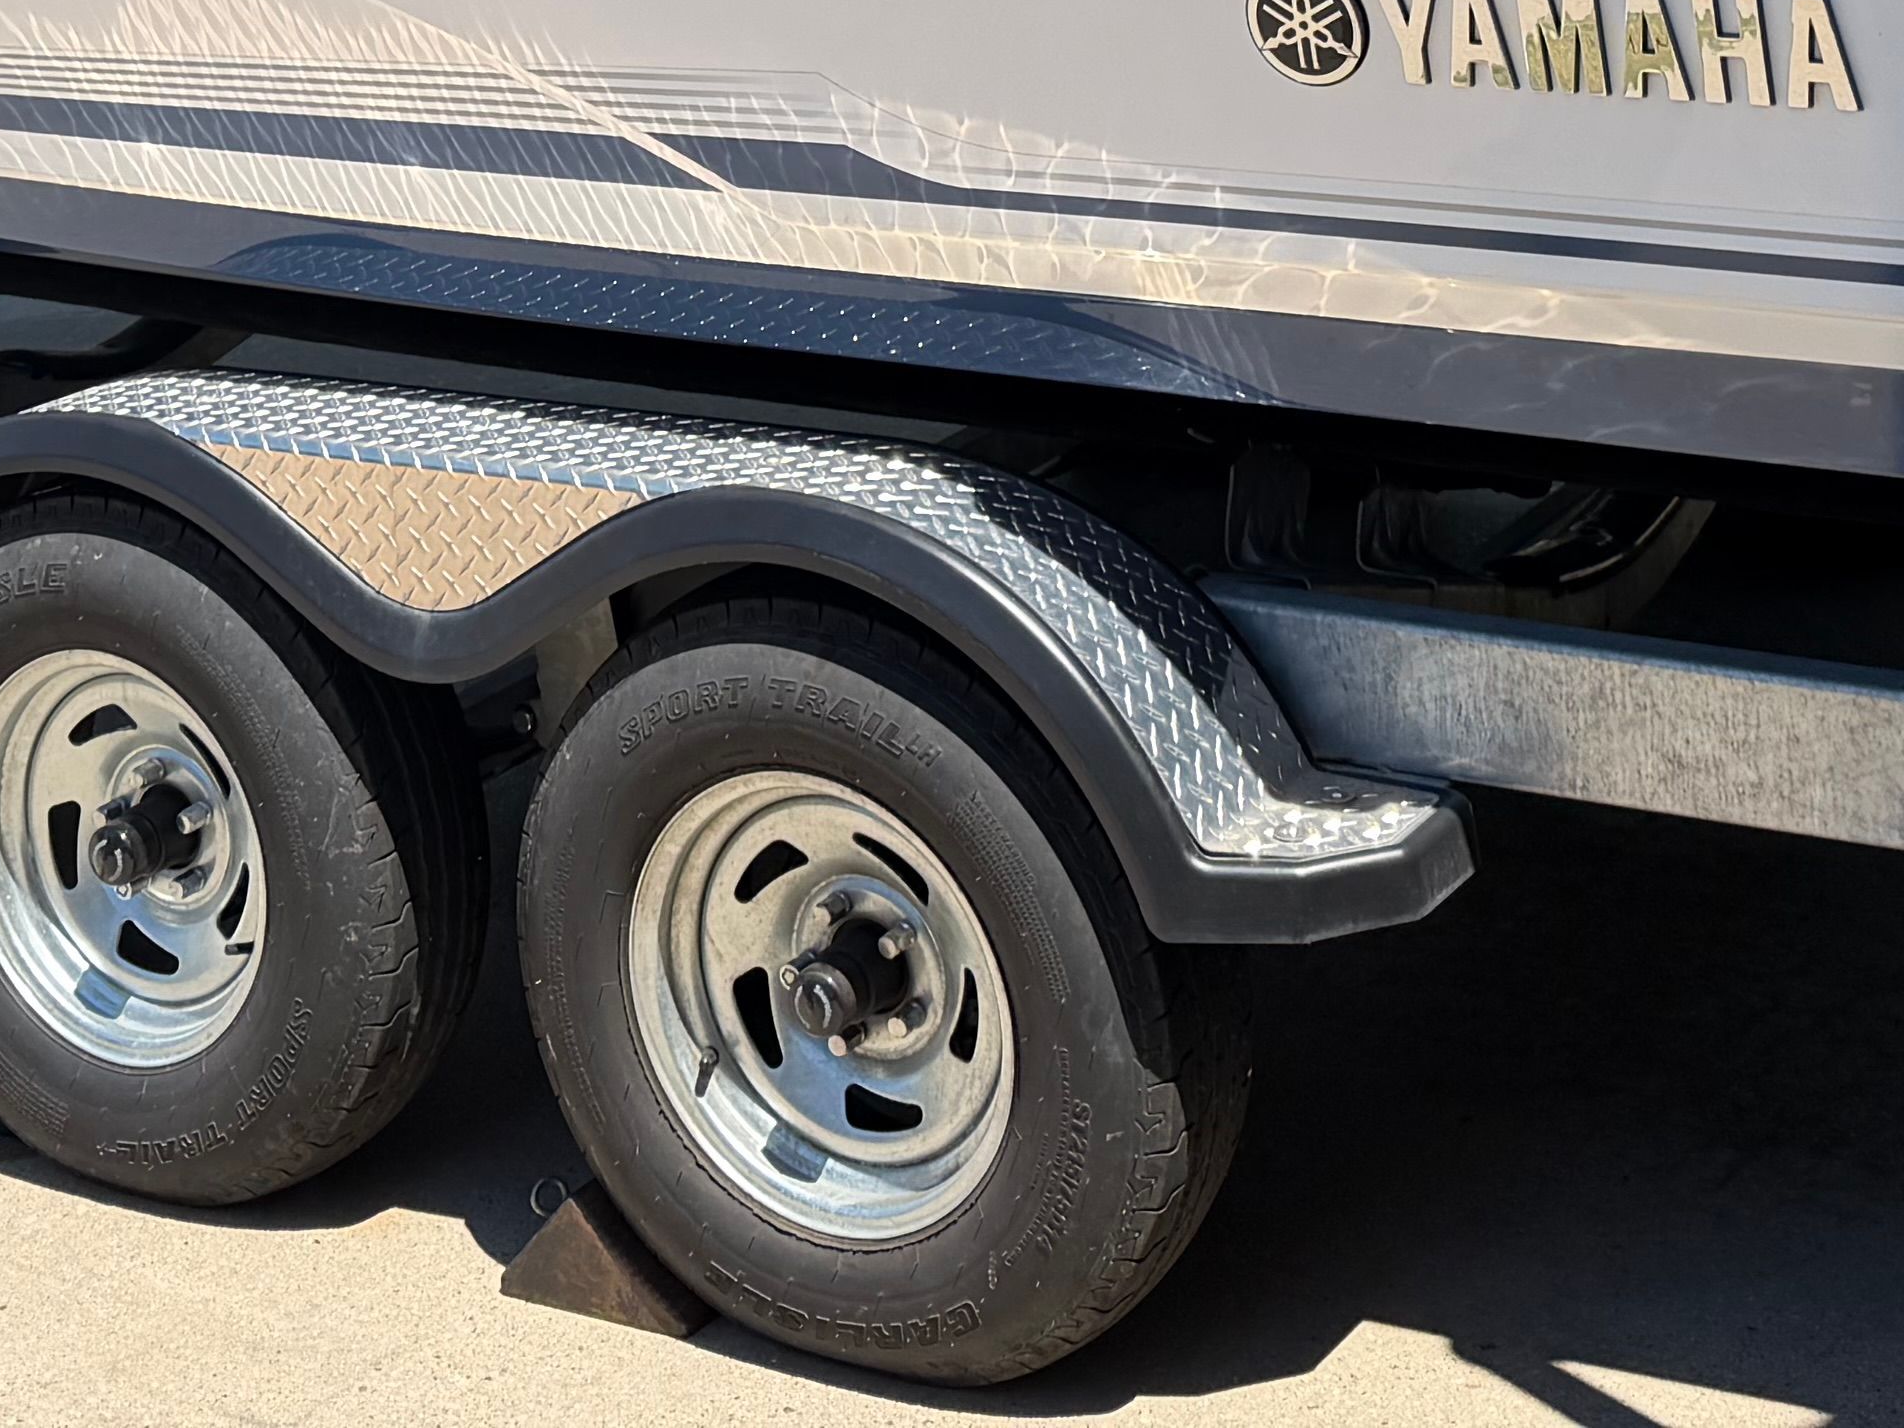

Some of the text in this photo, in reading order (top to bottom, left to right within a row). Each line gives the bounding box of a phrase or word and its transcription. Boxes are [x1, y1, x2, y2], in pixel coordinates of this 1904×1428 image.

[618, 675, 749, 756] SPORT
[768, 677, 905, 759] TRAIL
[116, 996, 314, 1164] SPORT TRAIL
[703, 1260, 983, 1350] CARLISLE
